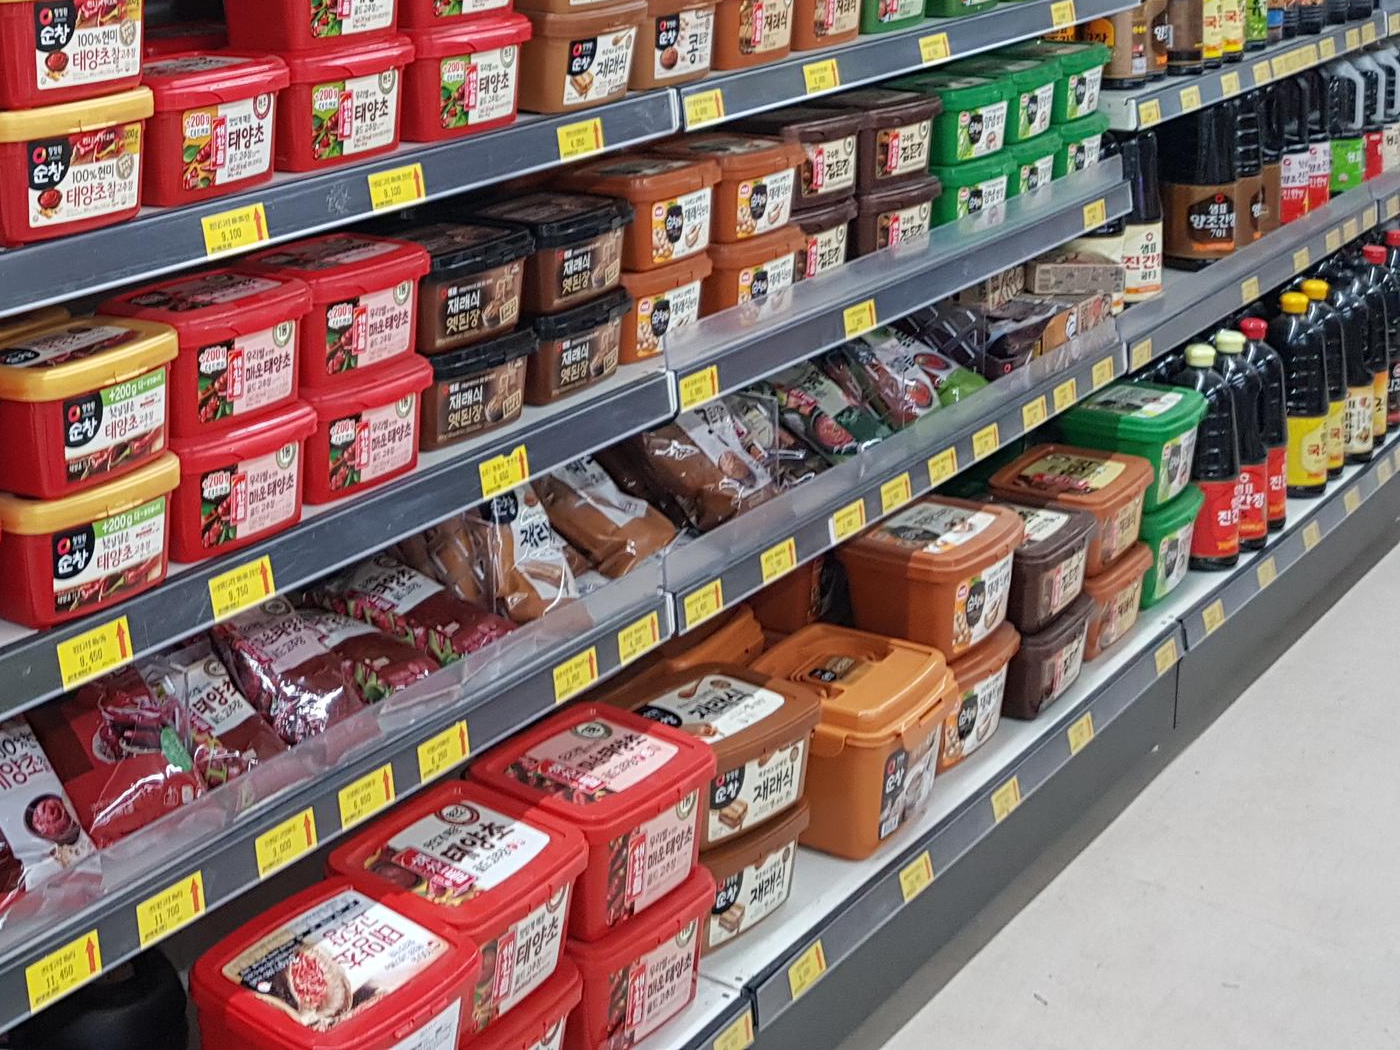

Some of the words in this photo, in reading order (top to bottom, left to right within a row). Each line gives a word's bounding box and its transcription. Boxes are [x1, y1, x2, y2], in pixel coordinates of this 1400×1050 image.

[39, 22, 71, 46] 순창
[596, 53, 630, 80] 재래식
[354, 99, 391, 125] 태양초
[227, 123, 265, 151] 태양초
[33, 159, 64, 184] 순창
[562, 251, 591, 277] 재래식
[446, 290, 481, 316] 재래식
[561, 339, 589, 363] 재래식
[448, 385, 484, 409] 재래식
[69, 418, 99, 443] 순창
[105, 418, 139, 440] 태양초
[58, 550, 90, 575] 순창
[96, 548, 134, 573] 태양초
[752, 769, 796, 804] 재래식
[750, 873, 788, 905] 재래식
[44, 969, 75, 990] 11,450
